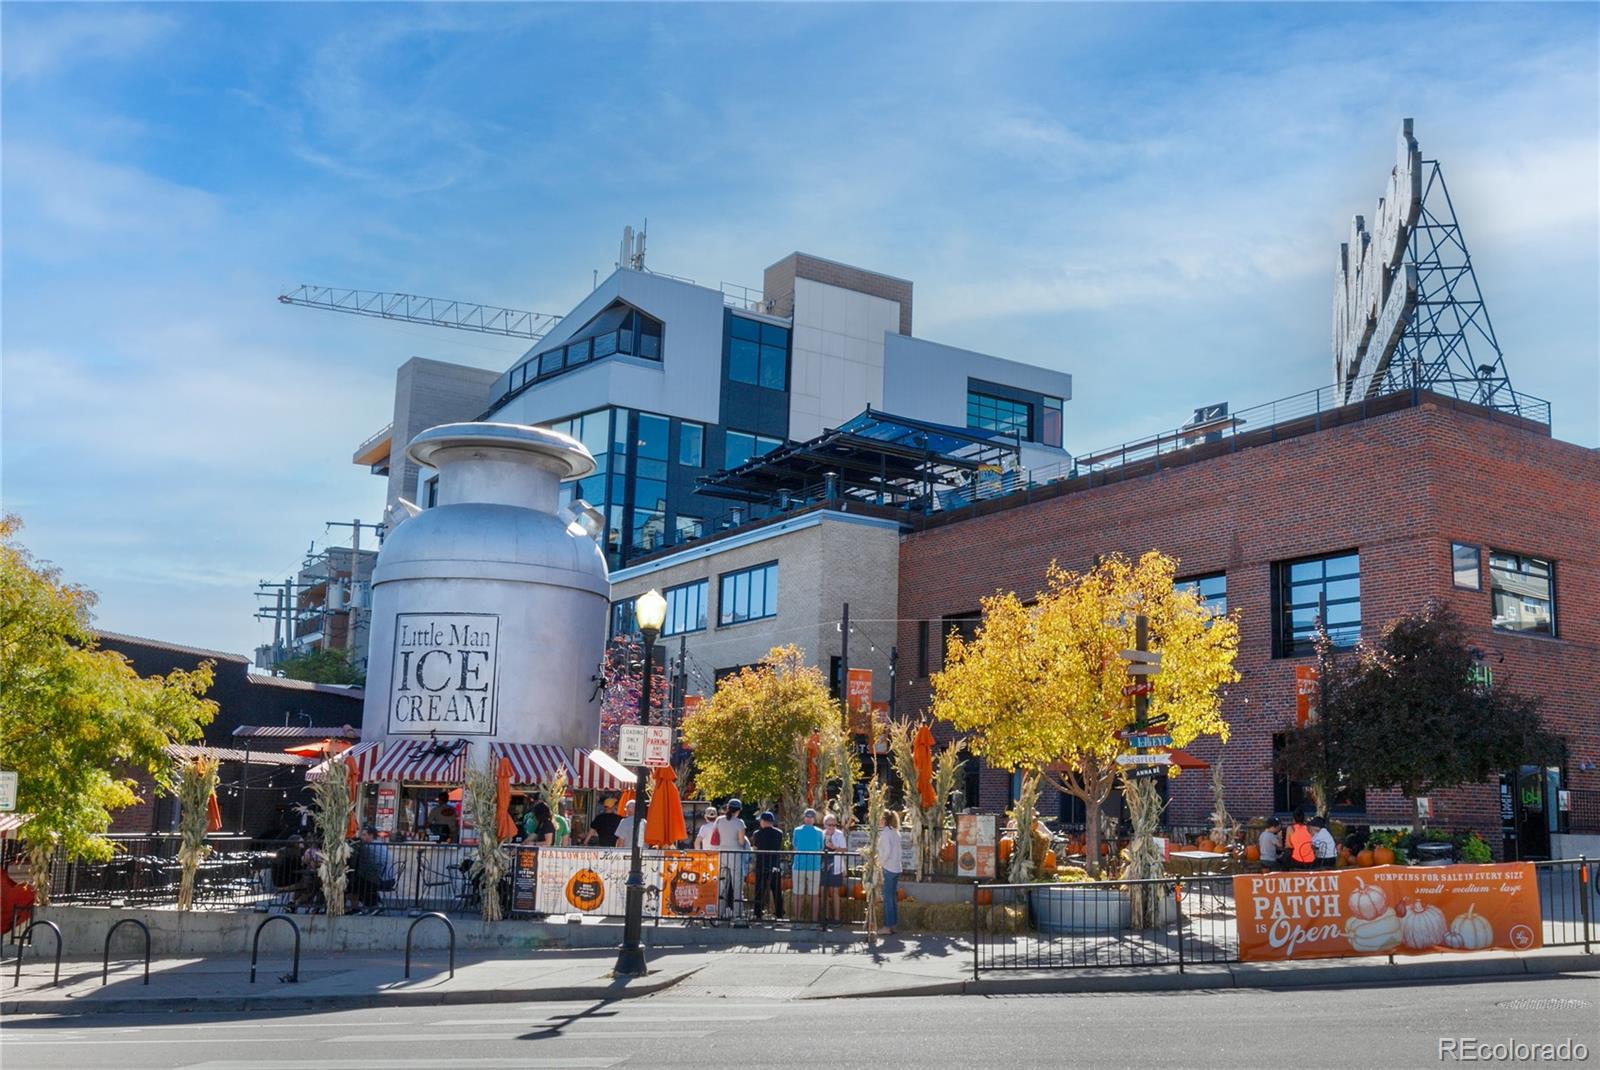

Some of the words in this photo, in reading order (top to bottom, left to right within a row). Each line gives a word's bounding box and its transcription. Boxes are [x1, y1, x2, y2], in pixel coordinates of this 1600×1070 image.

[401, 622, 444, 647] Little
[448, 623, 490, 647] Man
[397, 649, 489, 692] ICE
[395, 695, 488, 723] CREAM
[647, 738, 669, 746] PARKING
[653, 729, 663, 737] NO
[541, 850, 599, 860] HALLOWEEN
[1252, 875, 1340, 895] PUMPKIN
[1374, 873, 1420, 881] PUMPKINS
[1421, 873, 1439, 882] FOR
[1441, 873, 1463, 881] SALE
[1464, 872, 1473, 880] IN
[1475, 872, 1502, 880] EVERY
[1504, 871, 1524, 879] SIZE
[1414, 884, 1444, 894] small
[1451, 883, 1489, 893] medium
[1500, 883, 1522, 896] large
[1252, 894, 1341, 920] PATCH
[1269, 913, 1345, 956] Open
